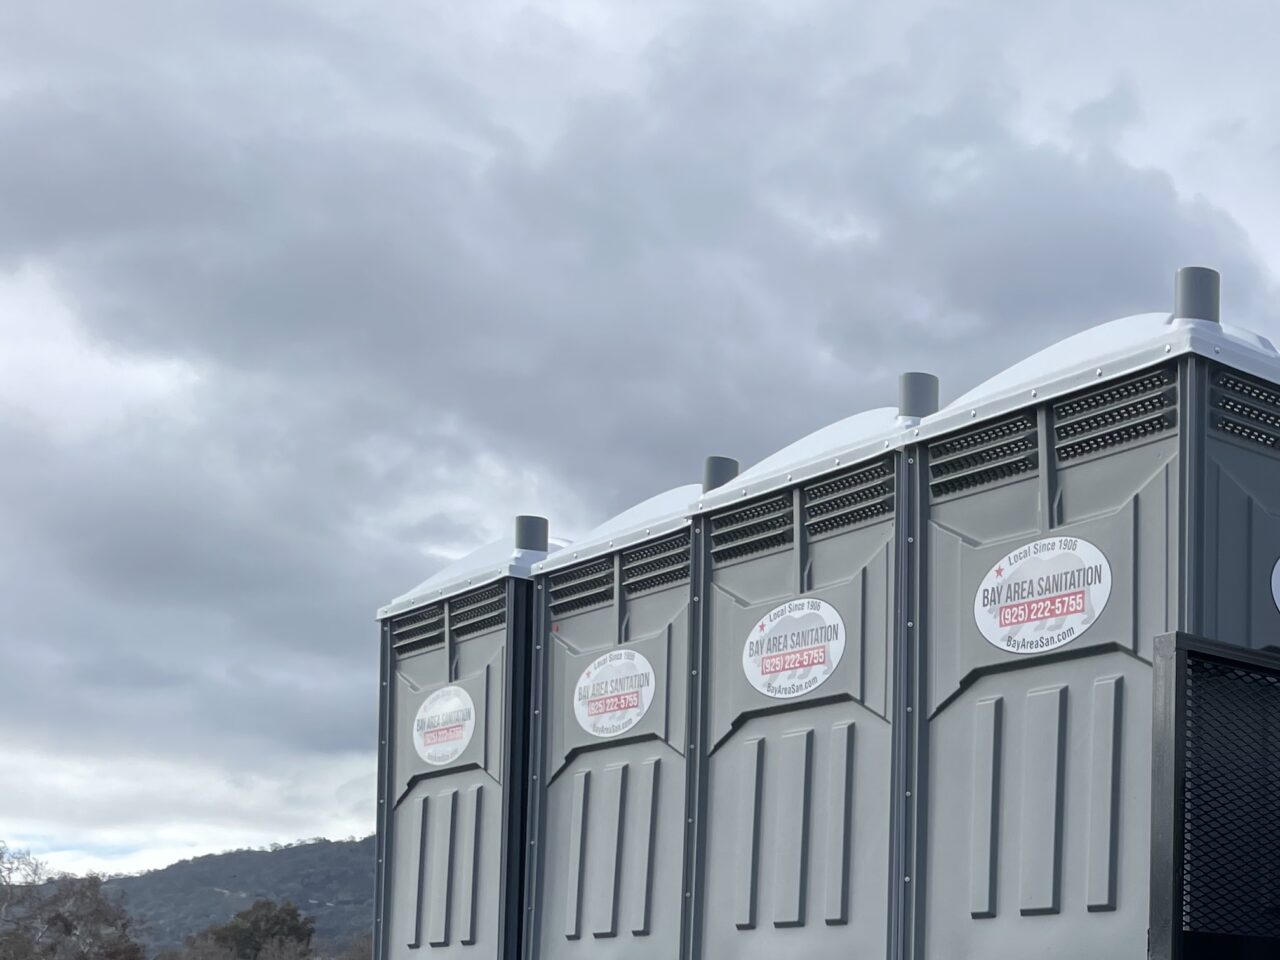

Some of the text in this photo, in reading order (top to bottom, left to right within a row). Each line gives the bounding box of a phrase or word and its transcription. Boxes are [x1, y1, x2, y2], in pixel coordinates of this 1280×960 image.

[1008, 539, 1078, 566] Local Since 1906
[982, 564, 1102, 607] BAY AREA SANITATION
[769, 600, 821, 622] Local Since 1906
[1001, 594, 1083, 625] (925) 222-5755
[749, 623, 839, 658] BAY AREA SANITATION
[1006, 626, 1075, 651] BayAreaSan.com
[762, 648, 824, 673] (925) 222-5755
[578, 672, 650, 701] BAY AREA SANITATION
[767, 676, 818, 696] BayAreaSan.com
